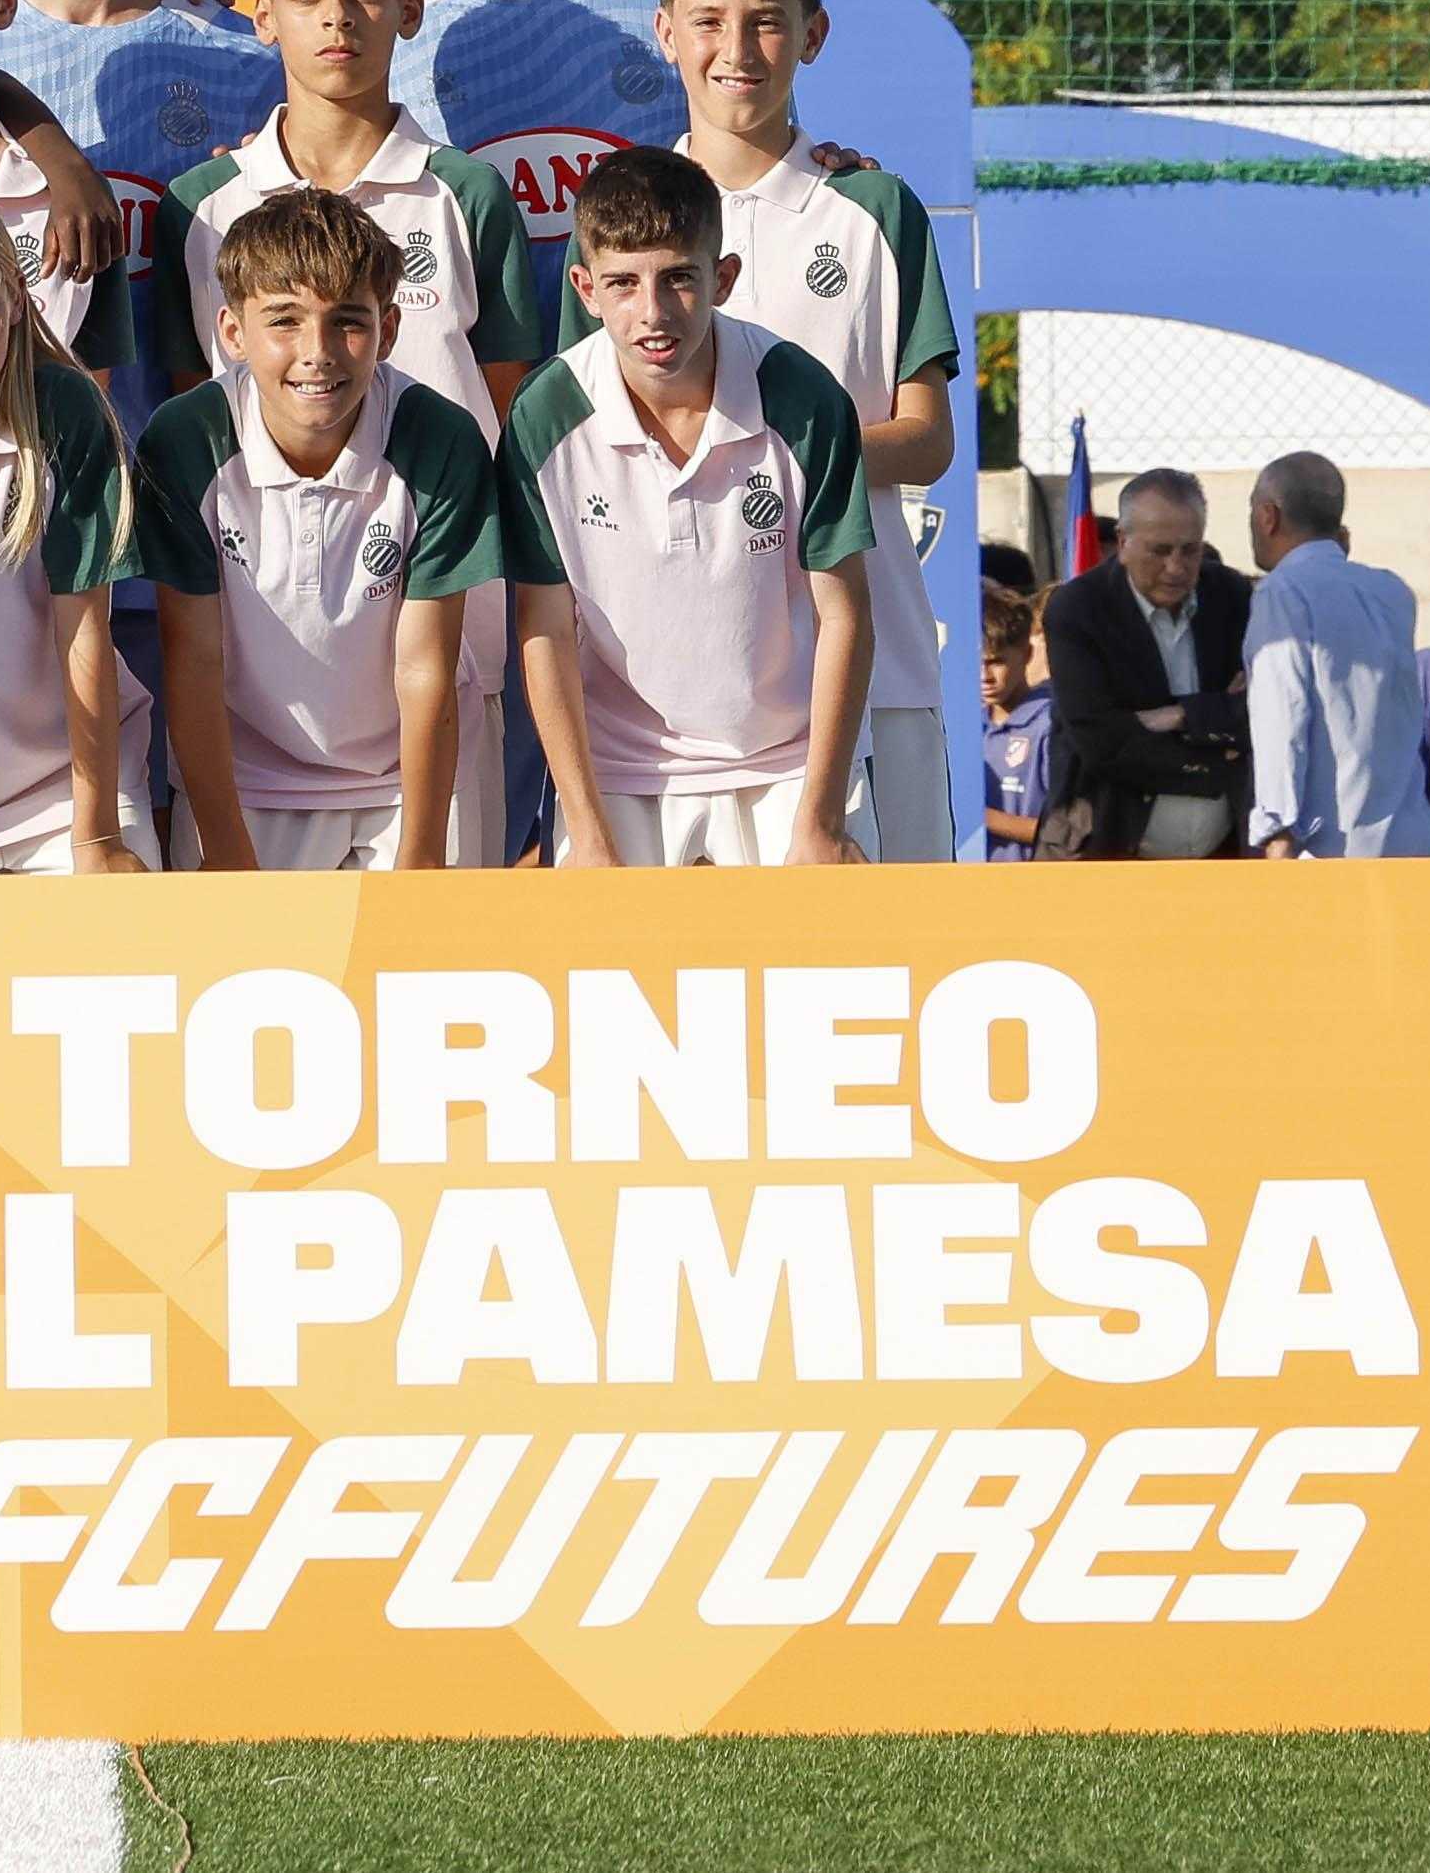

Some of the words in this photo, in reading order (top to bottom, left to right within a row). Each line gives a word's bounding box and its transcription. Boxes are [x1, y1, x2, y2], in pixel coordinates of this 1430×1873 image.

[397, 291, 431, 305] DANI
[581, 517, 620, 531] KELME
[750, 534, 782, 552] DANI
[11, 960, 1098, 1170] TORNEO
[226, 1177, 1420, 1387] PAMESA
